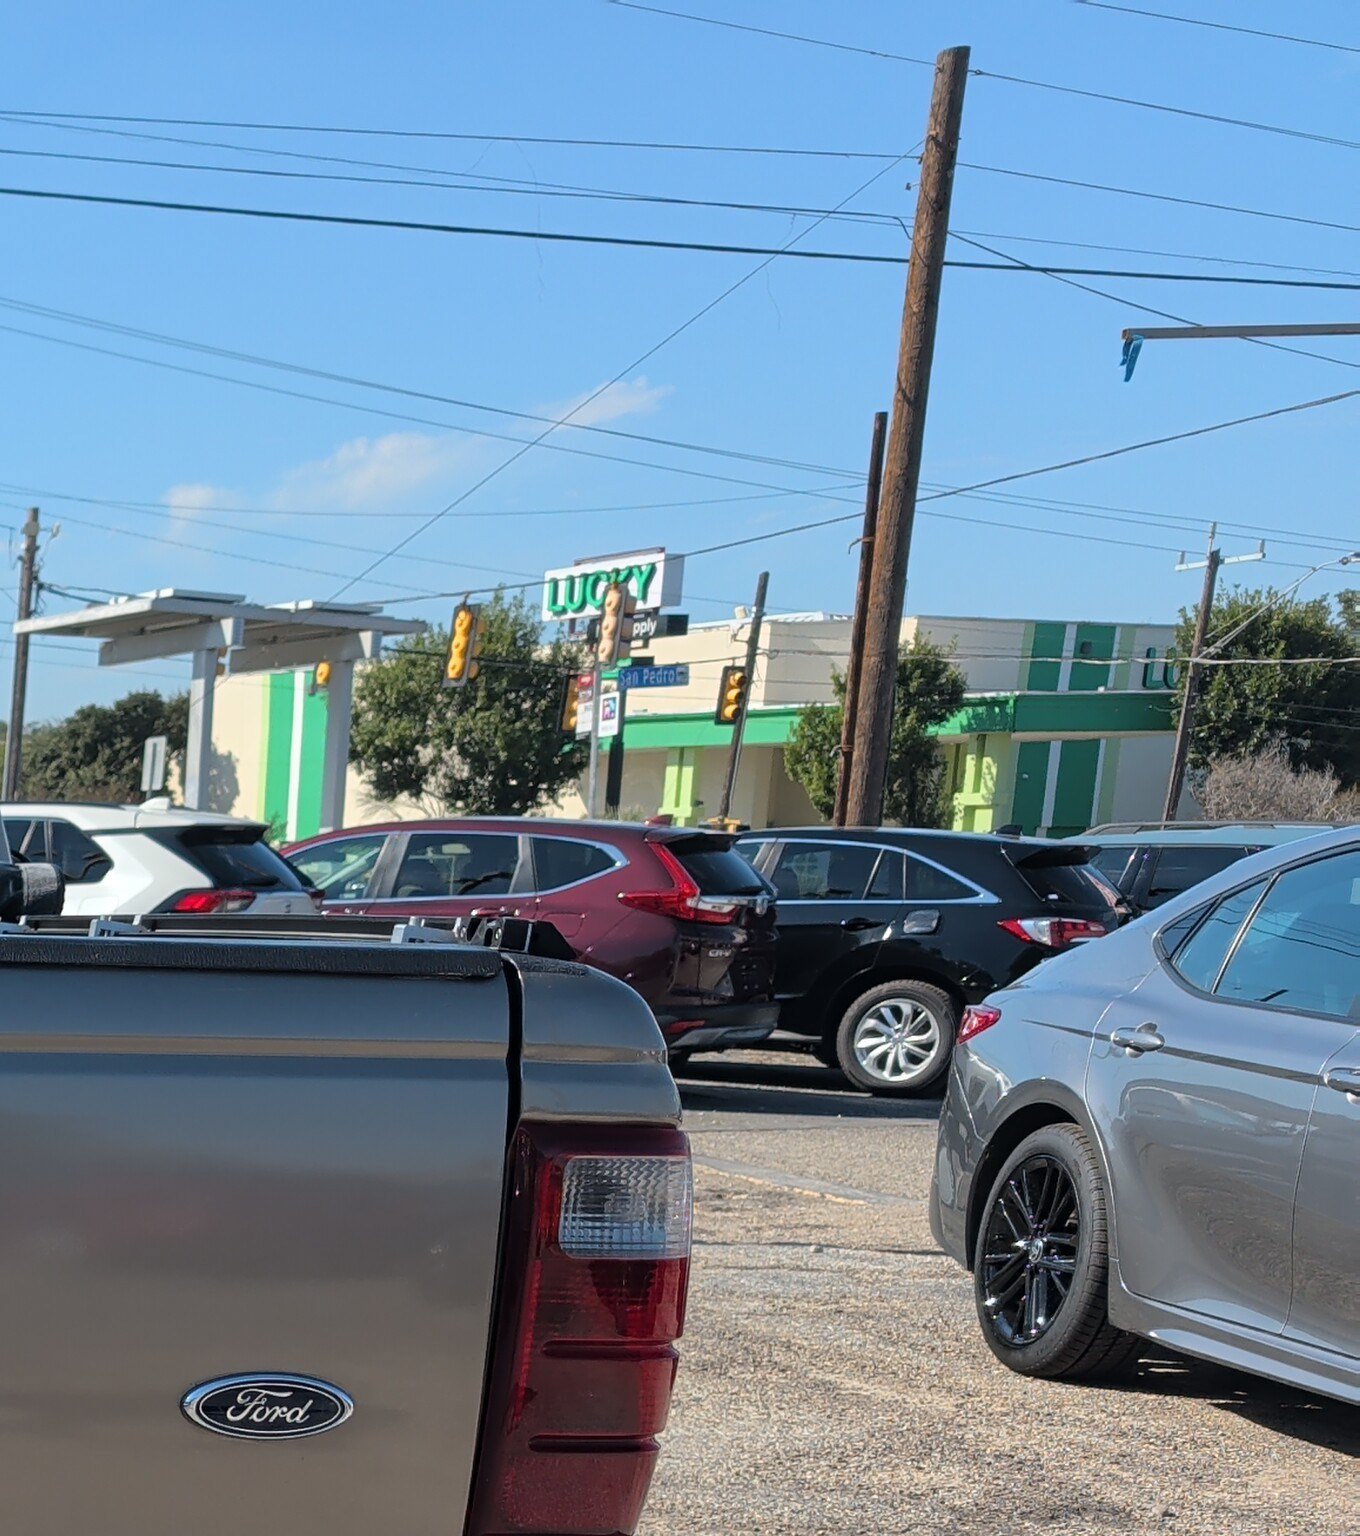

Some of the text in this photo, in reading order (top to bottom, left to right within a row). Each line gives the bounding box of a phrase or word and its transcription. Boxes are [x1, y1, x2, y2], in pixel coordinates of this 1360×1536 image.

[620, 669, 639, 687] San
[643, 666, 676, 685] Pedro
[226, 1387, 314, 1424] Ford
